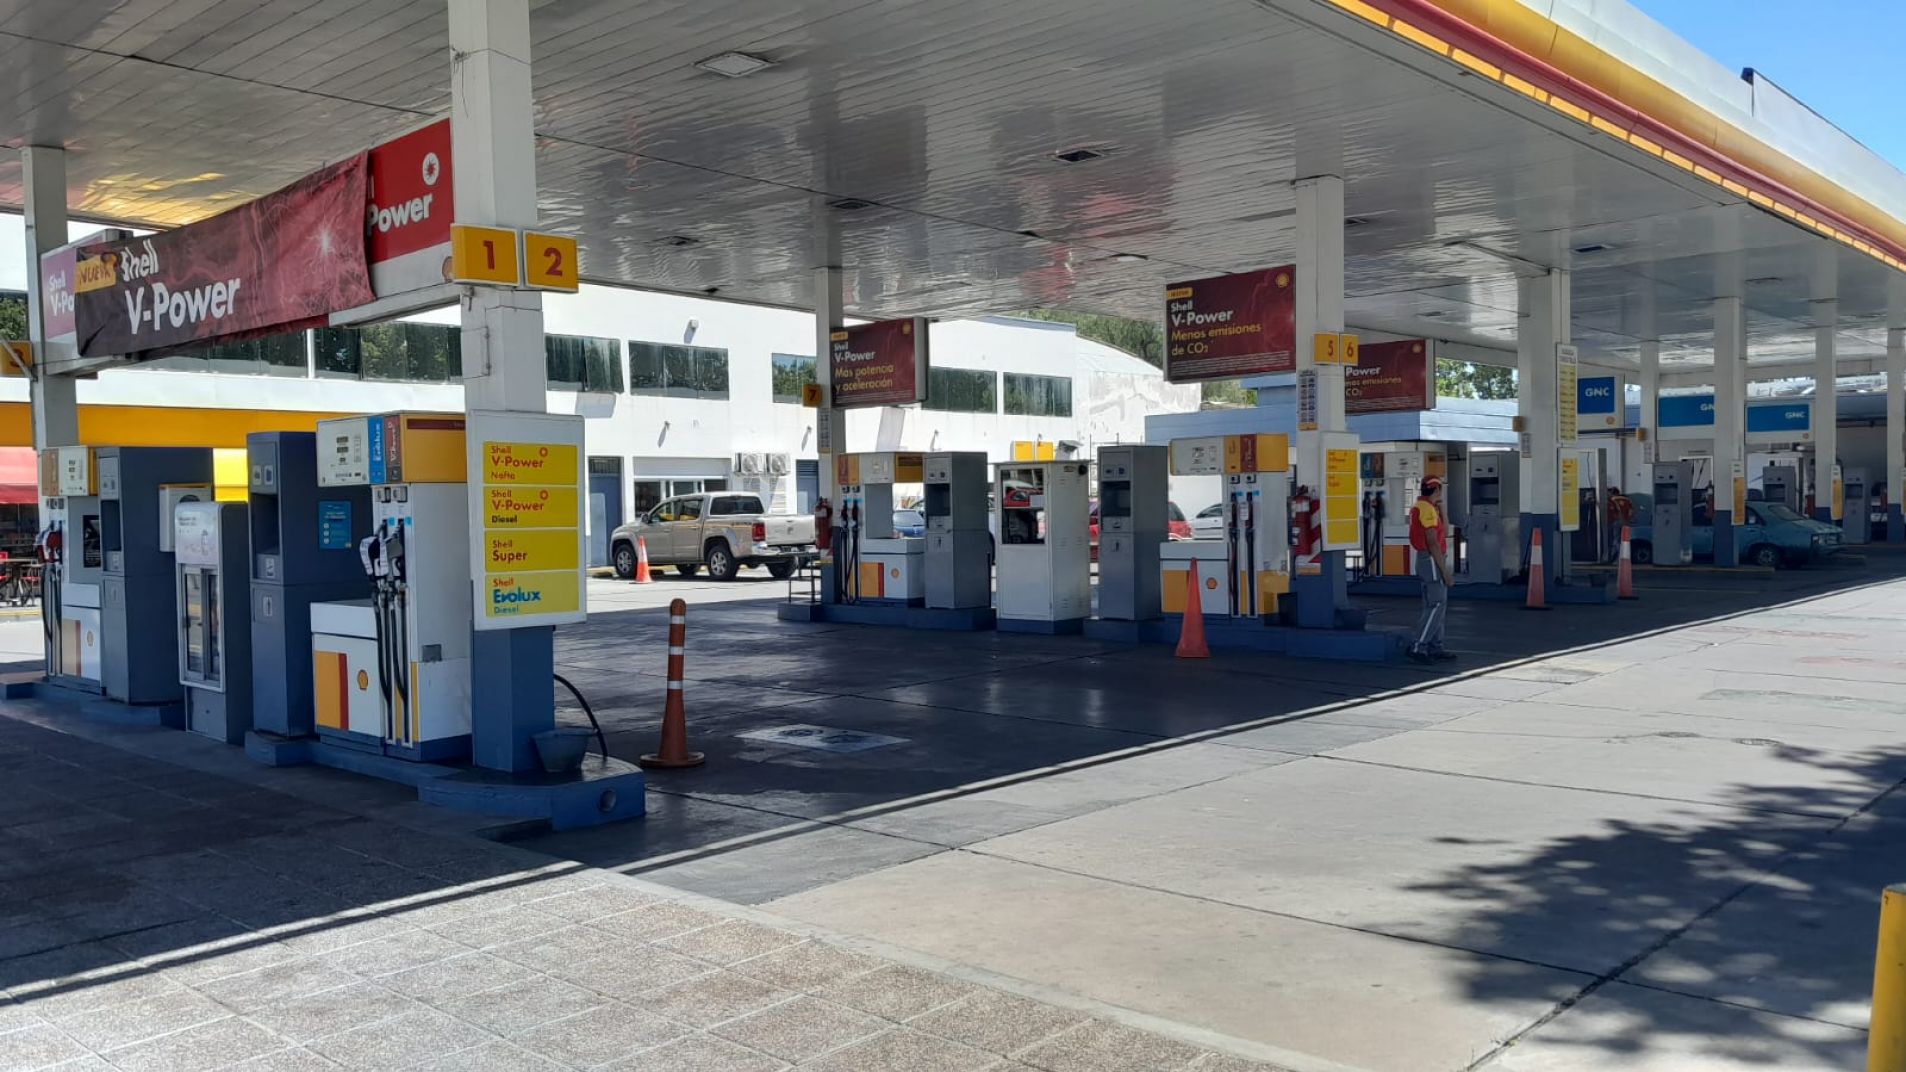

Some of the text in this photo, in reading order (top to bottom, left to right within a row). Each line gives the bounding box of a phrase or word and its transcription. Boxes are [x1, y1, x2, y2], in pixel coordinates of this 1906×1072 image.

[367, 193, 433, 236] Power
[120, 238, 160, 283] Shell
[482, 240, 496, 270] 1
[543, 247, 564, 277] 2
[49, 270, 67, 292] Shell
[50, 289, 75, 317] V-Po
[125, 277, 241, 335] V-Power
[1170, 300, 1193, 312] Shell
[1171, 310, 1234, 327] V-Power
[1171, 323, 1262, 341] Menos emisiones
[1171, 345, 1185, 356] de
[1327, 340, 1334, 356] 5
[1346, 341, 1354, 357] 6
[834, 351, 876, 363] V-Power
[854, 364, 895, 379] potencia
[1345, 366, 1381, 376] Power
[808, 389, 817, 401] 7
[1584, 386, 1610, 397] GNC
[1700, 403, 1715, 411] GN
[1784, 411, 1806, 419] GNC
[490, 445, 512, 454] Shell
[491, 455, 544, 468] V-Power
[491, 489, 512, 498] Shell
[491, 499, 545, 511] V-Power
[491, 514, 518, 523] Diesel
[492, 539, 513, 548] Shell
[492, 549, 528, 564] Super
[492, 577, 514, 587] Shell
[493, 586, 541, 604] Evolux
[493, 604, 519, 614] Diesel
